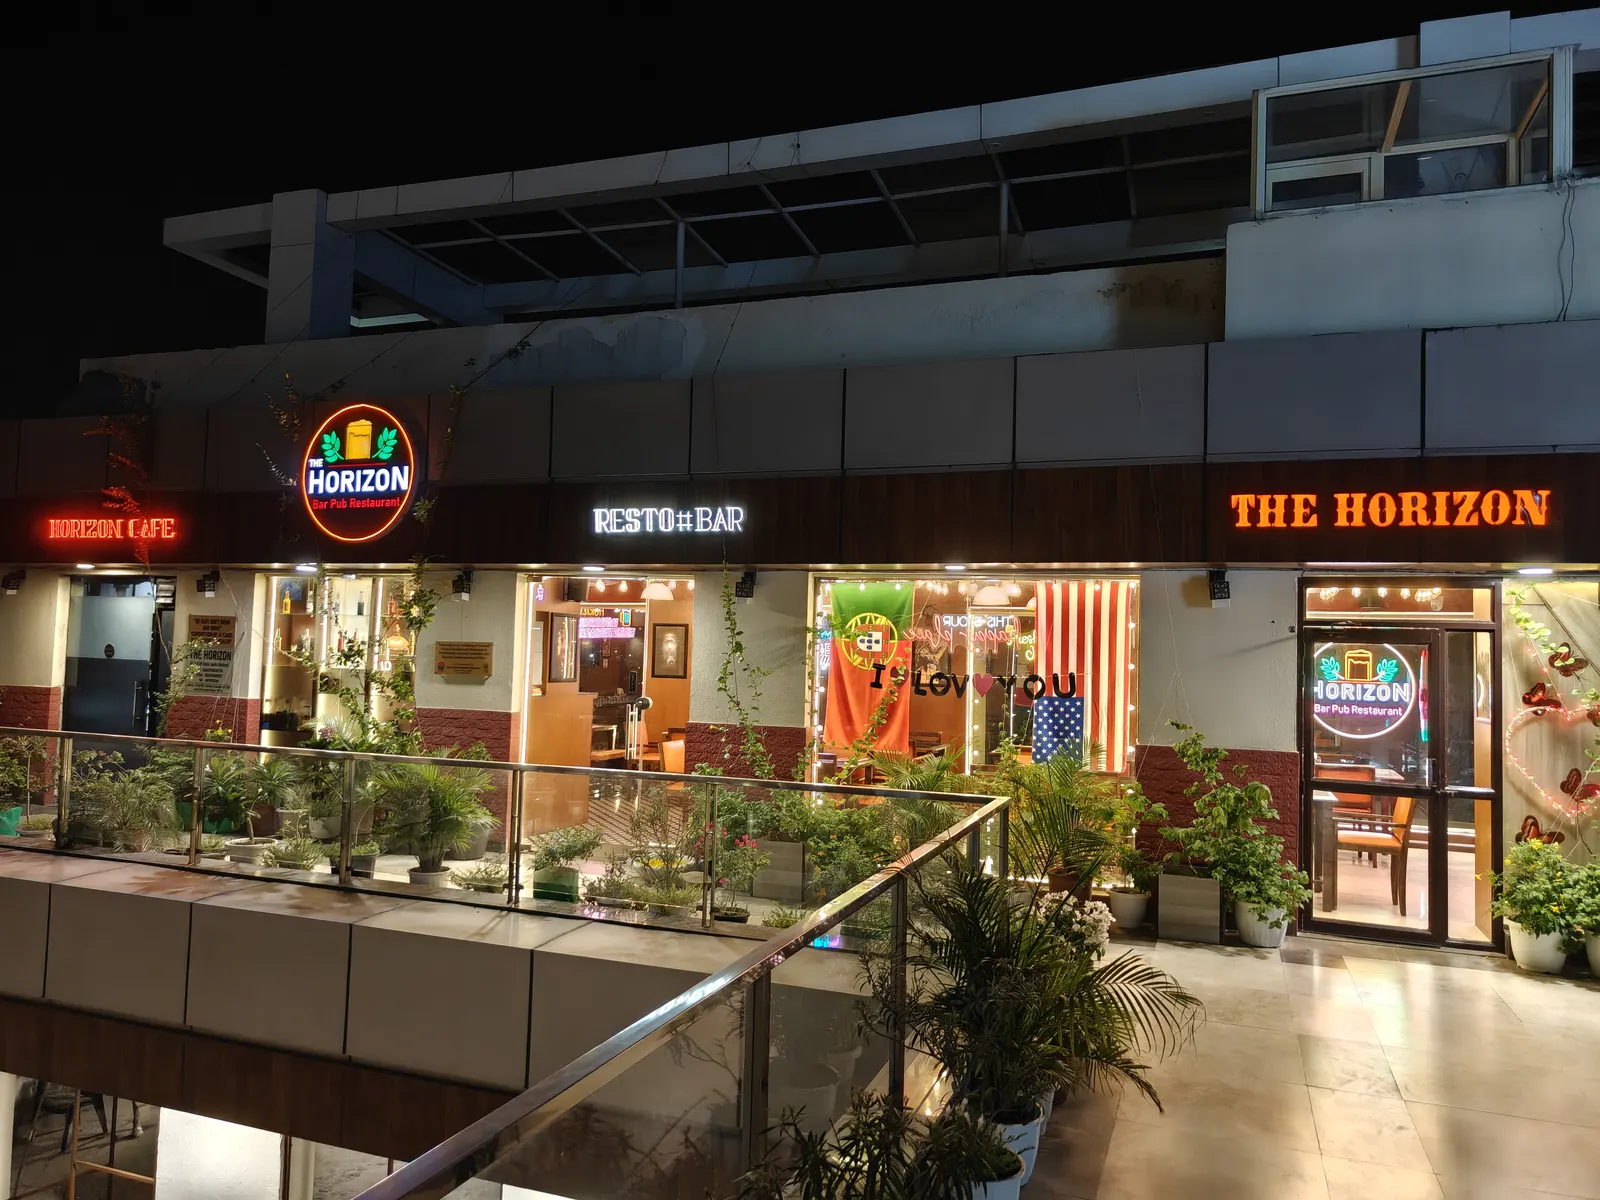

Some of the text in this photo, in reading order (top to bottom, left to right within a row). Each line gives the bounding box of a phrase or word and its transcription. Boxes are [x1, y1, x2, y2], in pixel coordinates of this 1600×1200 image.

[309, 458, 323, 468] THE
[308, 465, 410, 494] HORIZON
[312, 497, 400, 509] Bar Pub Restaurant
[1231, 489, 1550, 528] THE HORIZON
[49, 518, 175, 539] HORIZON CAFE
[203, 650, 232, 661] HORIZON
[870, 663, 886, 689] I
[1314, 703, 1403, 716] Bar Pub Restaurant
